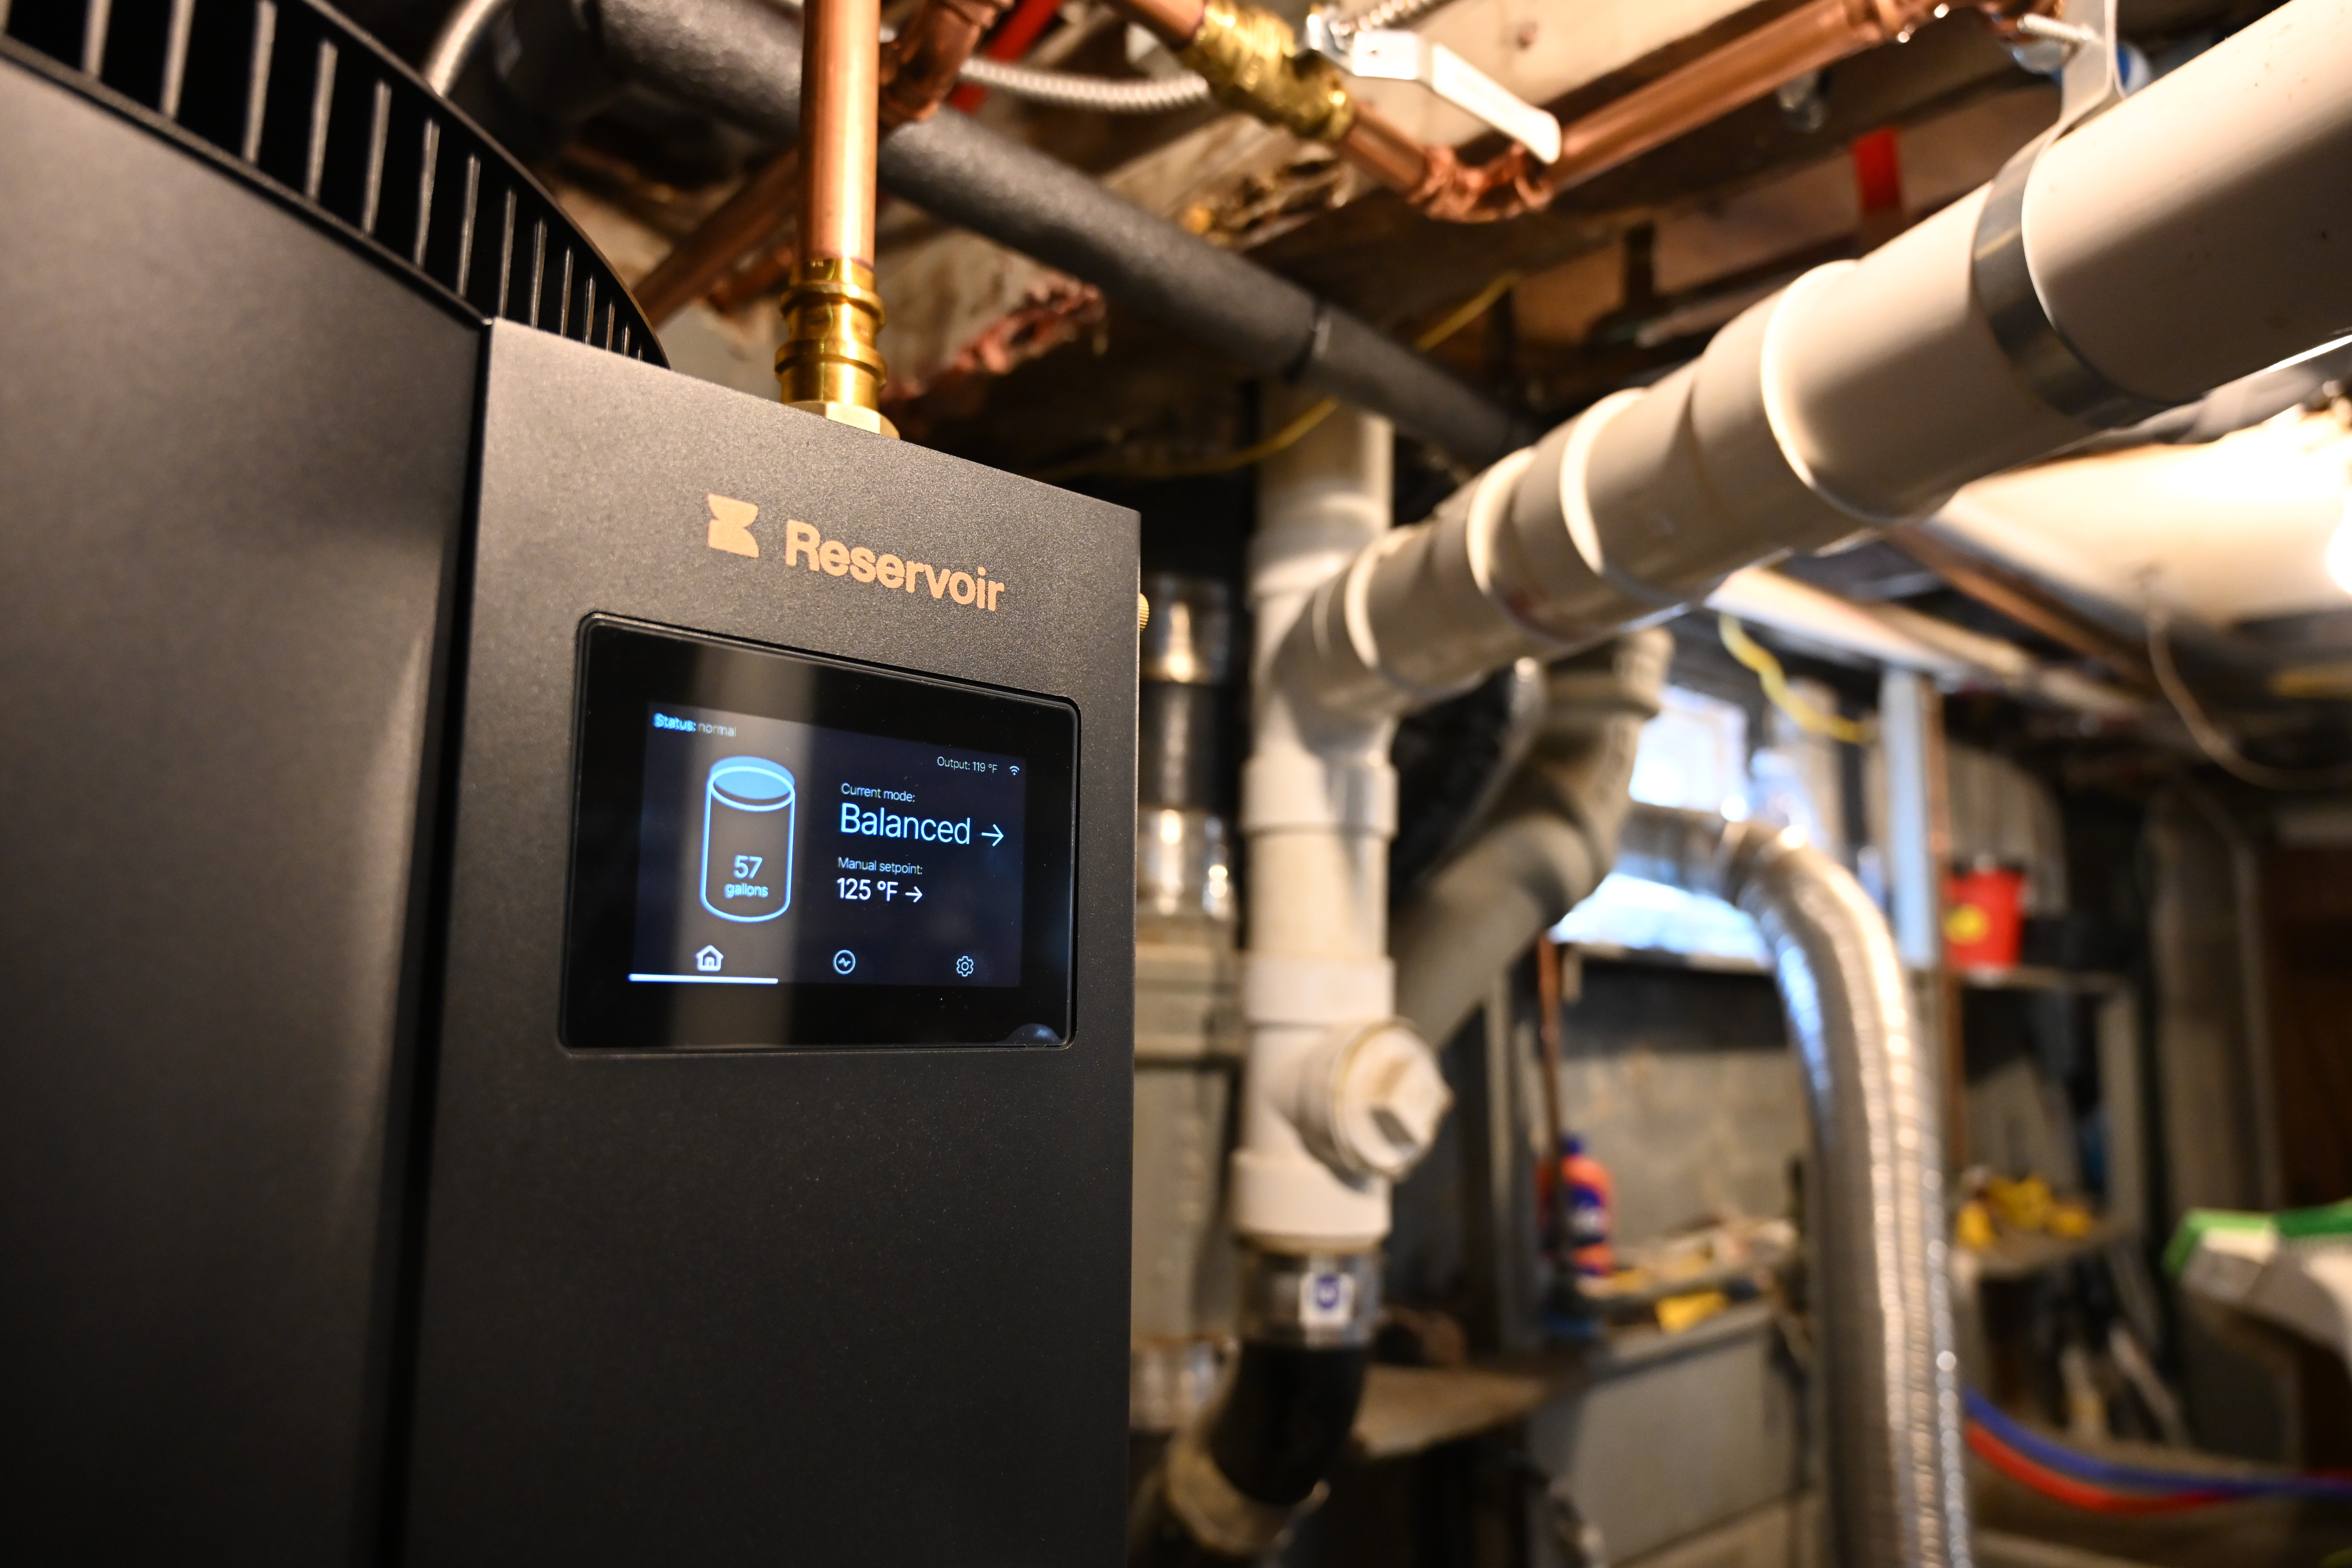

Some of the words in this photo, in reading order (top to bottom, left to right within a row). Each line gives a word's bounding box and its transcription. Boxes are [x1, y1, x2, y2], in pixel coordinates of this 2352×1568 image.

[786, 519, 1004, 611] Reservoir
[654, 713, 696, 732] Status:
[699, 723, 736, 736] normal
[937, 756, 970, 770] Output:
[973, 761, 985, 772] 119
[989, 764, 998, 773] °F
[841, 783, 881, 798] Current
[884, 790, 915, 802] mode:
[841, 802, 970, 844] Balanced
[734, 855, 763, 879] 57
[838, 857, 877, 871] Manual
[879, 863, 922, 875] setpoint:
[724, 882, 768, 899] gallons
[837, 878, 871, 900] 125
[877, 880, 898, 901] °F
